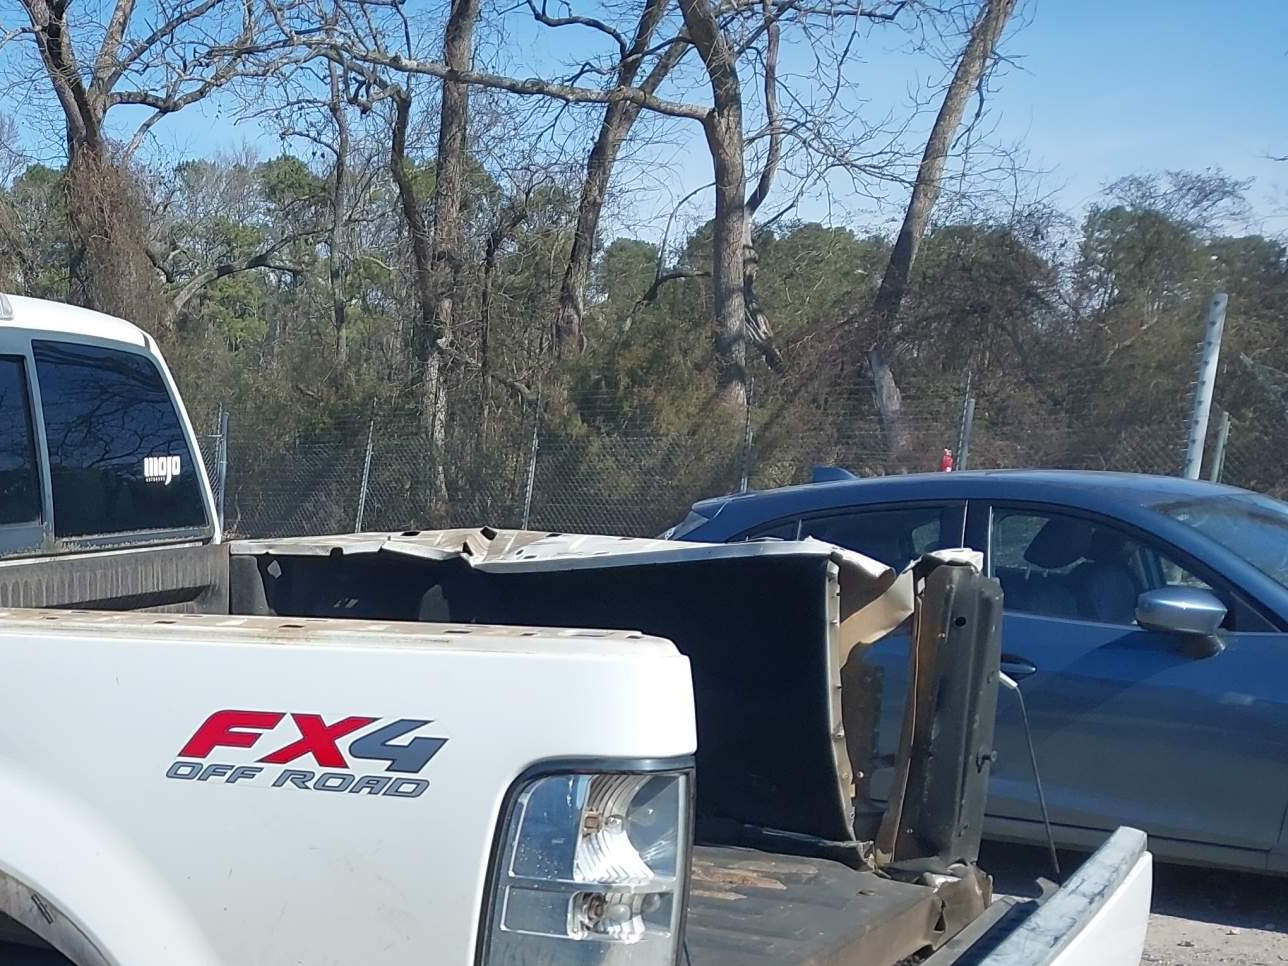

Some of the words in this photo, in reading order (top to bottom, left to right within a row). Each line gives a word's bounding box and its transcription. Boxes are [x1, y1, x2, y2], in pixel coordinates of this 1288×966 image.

[177, 709, 449, 774] FX4
[166, 761, 264, 782] OFF
[272, 769, 430, 798] ROAD
